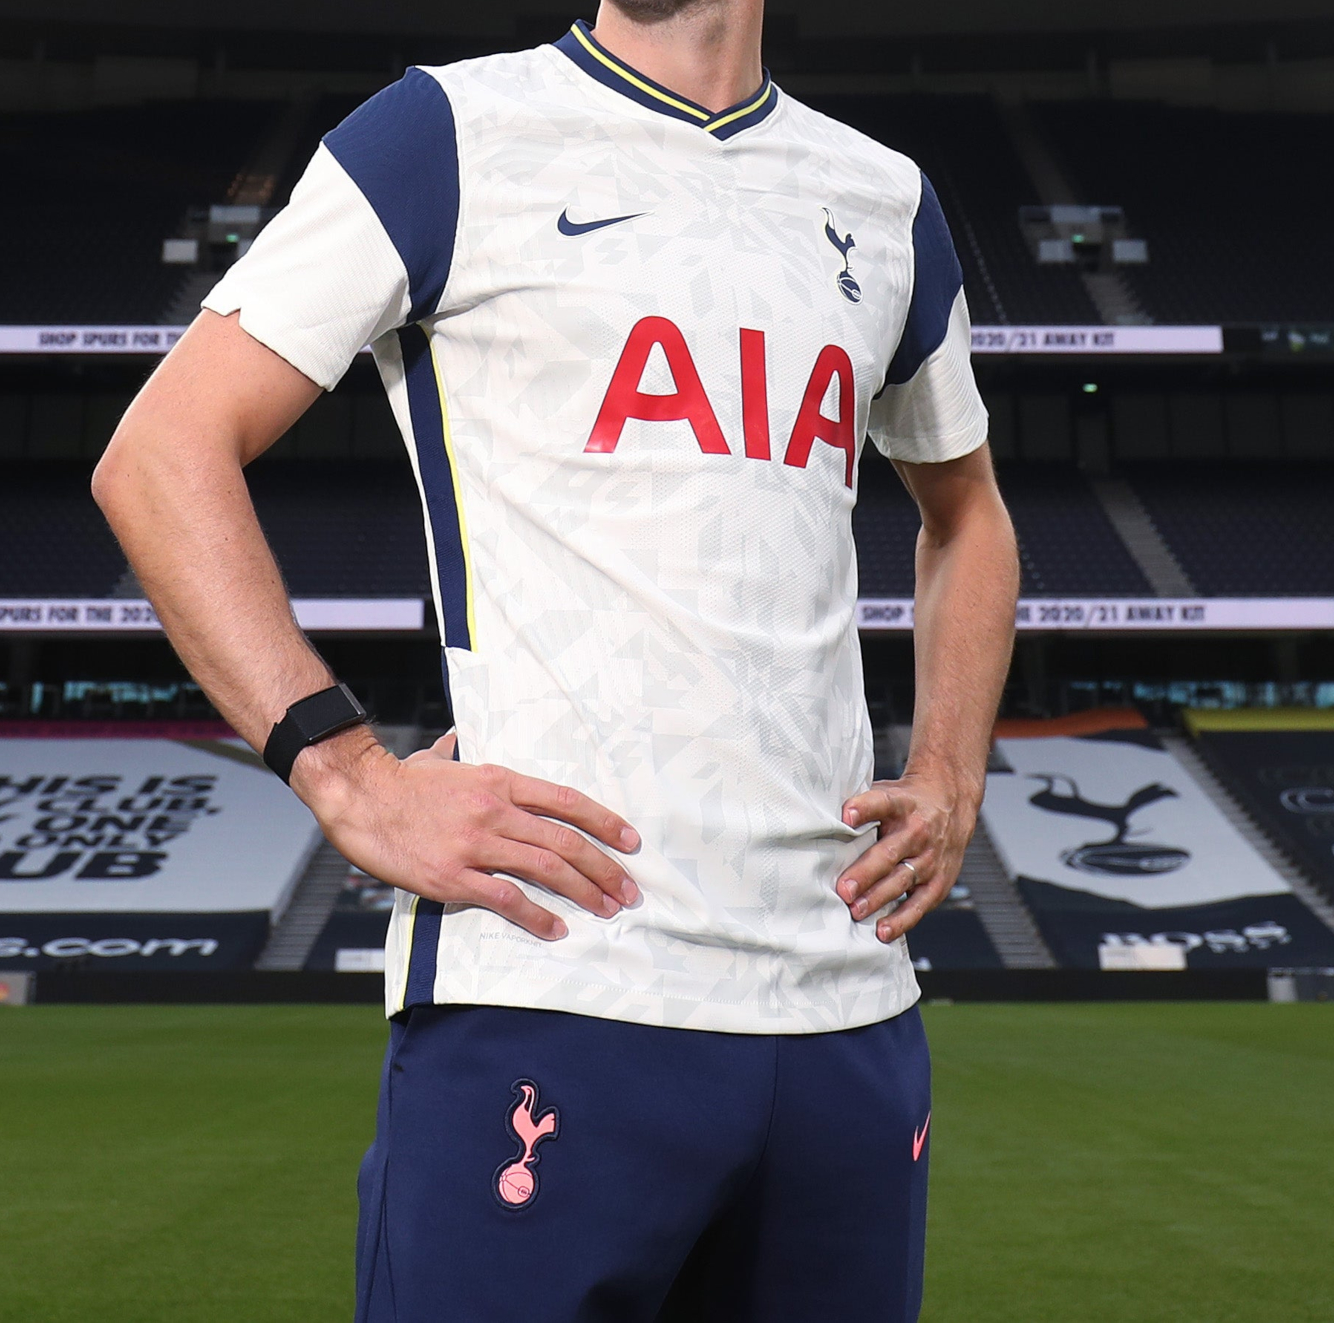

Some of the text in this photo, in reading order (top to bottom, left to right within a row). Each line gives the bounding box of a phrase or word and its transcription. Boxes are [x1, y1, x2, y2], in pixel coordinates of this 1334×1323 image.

[38, 332, 77, 346] SHOP
[82, 332, 127, 346] SPURS
[132, 332, 161, 346] FOR
[1042, 333, 1087, 346] AWAY
[1092, 333, 1115, 346] KIT
[583, 315, 855, 489] AIA
[47, 605, 78, 622] FOR
[84, 605, 112, 622] THE
[861, 606, 904, 622] SHOP
[1124, 606, 1175, 622] AWAY
[1180, 606, 1205, 622] KIT
[138, 775, 218, 796] IS
[33, 813, 194, 834] ONE
[15, 832, 177, 850] ONLY
[479, 931, 501, 940] NIKE
